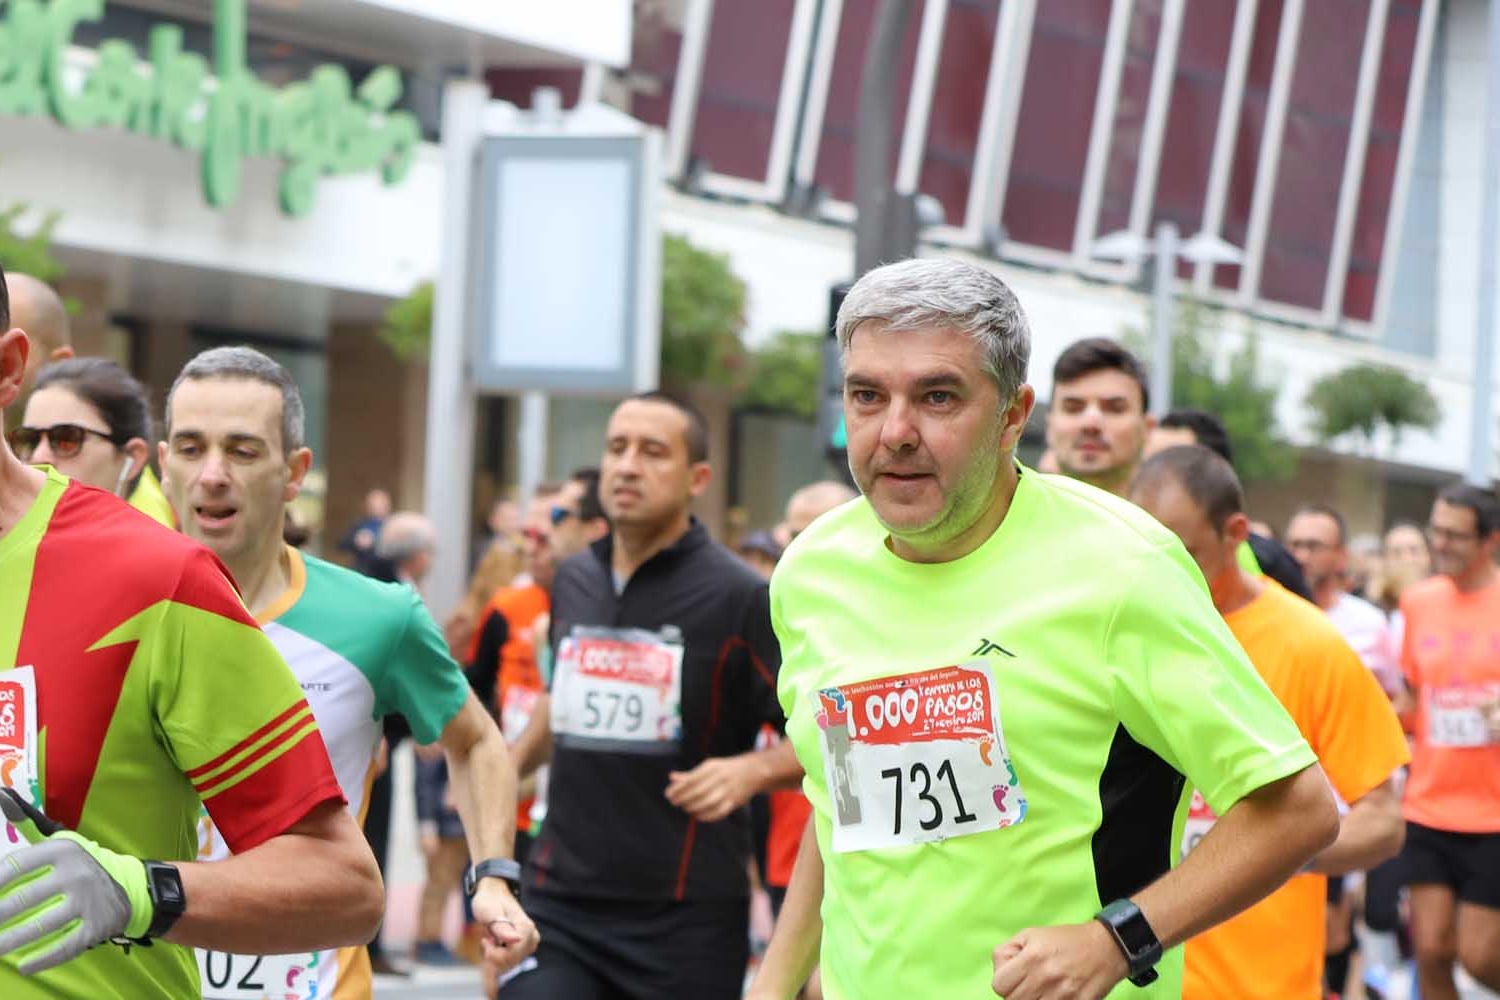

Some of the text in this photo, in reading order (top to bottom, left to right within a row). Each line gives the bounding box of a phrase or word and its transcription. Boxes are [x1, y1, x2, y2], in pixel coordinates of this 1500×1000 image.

[925, 690, 984, 717] PASOS
[966, 678, 982, 689] LOS
[584, 690, 643, 732] 579
[846, 689, 919, 738] 1.000
[881, 759, 977, 835] 731
